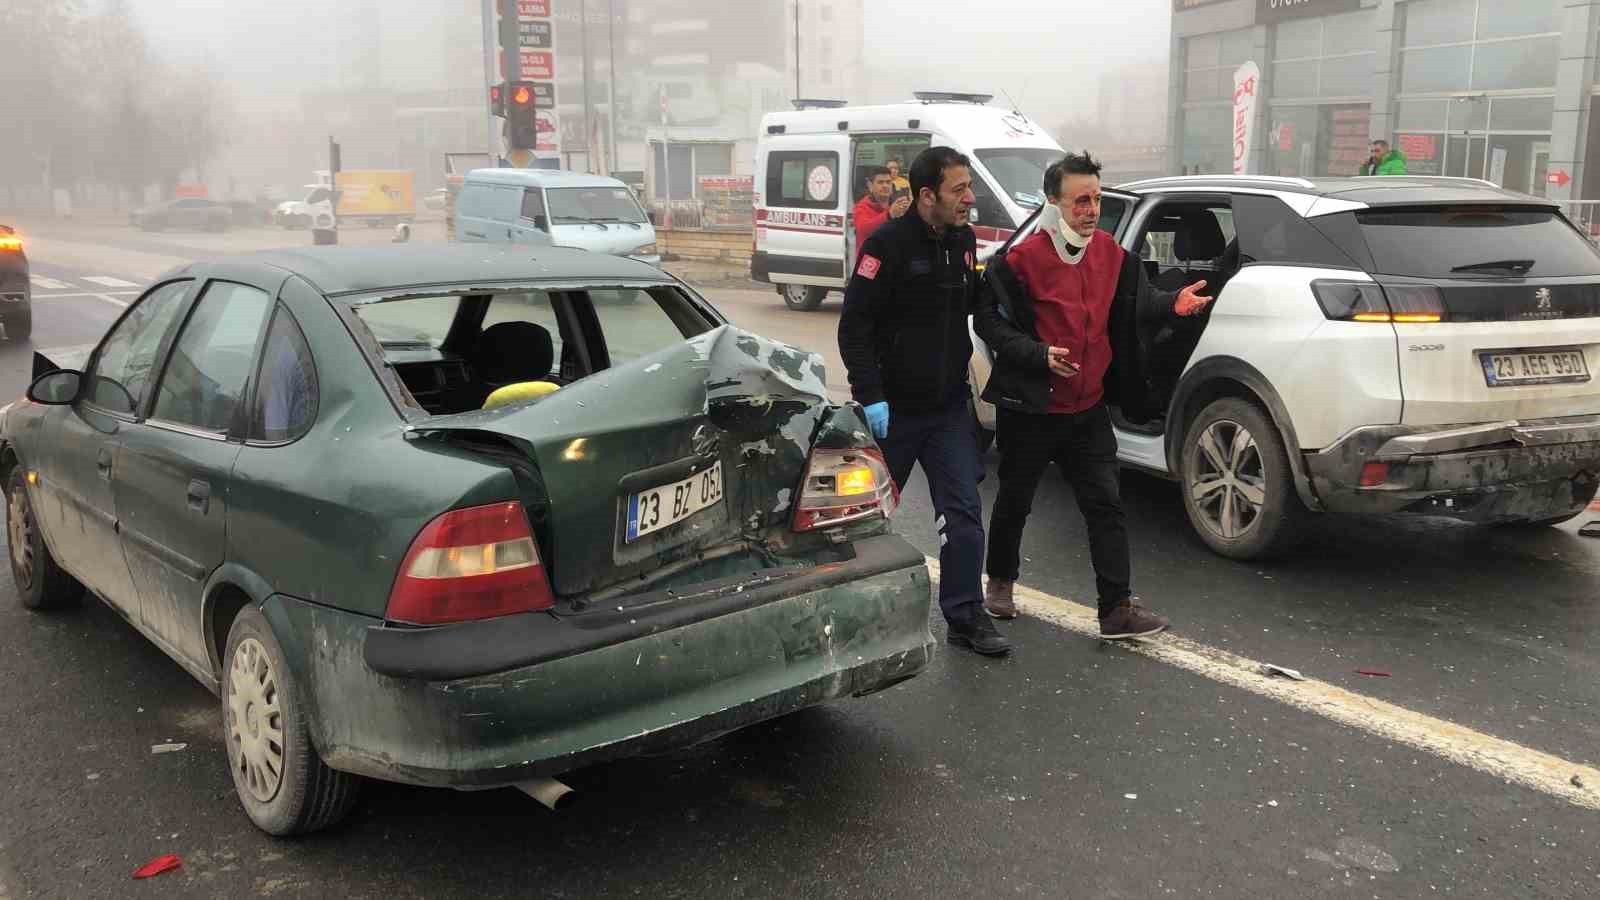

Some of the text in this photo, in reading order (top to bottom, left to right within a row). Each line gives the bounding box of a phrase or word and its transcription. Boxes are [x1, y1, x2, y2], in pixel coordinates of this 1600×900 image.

[767, 210, 827, 227] AMBULANS
[1494, 356, 1514, 377] 23
[1552, 353, 1581, 374] 950
[639, 466, 721, 531] 23 BZ 052
